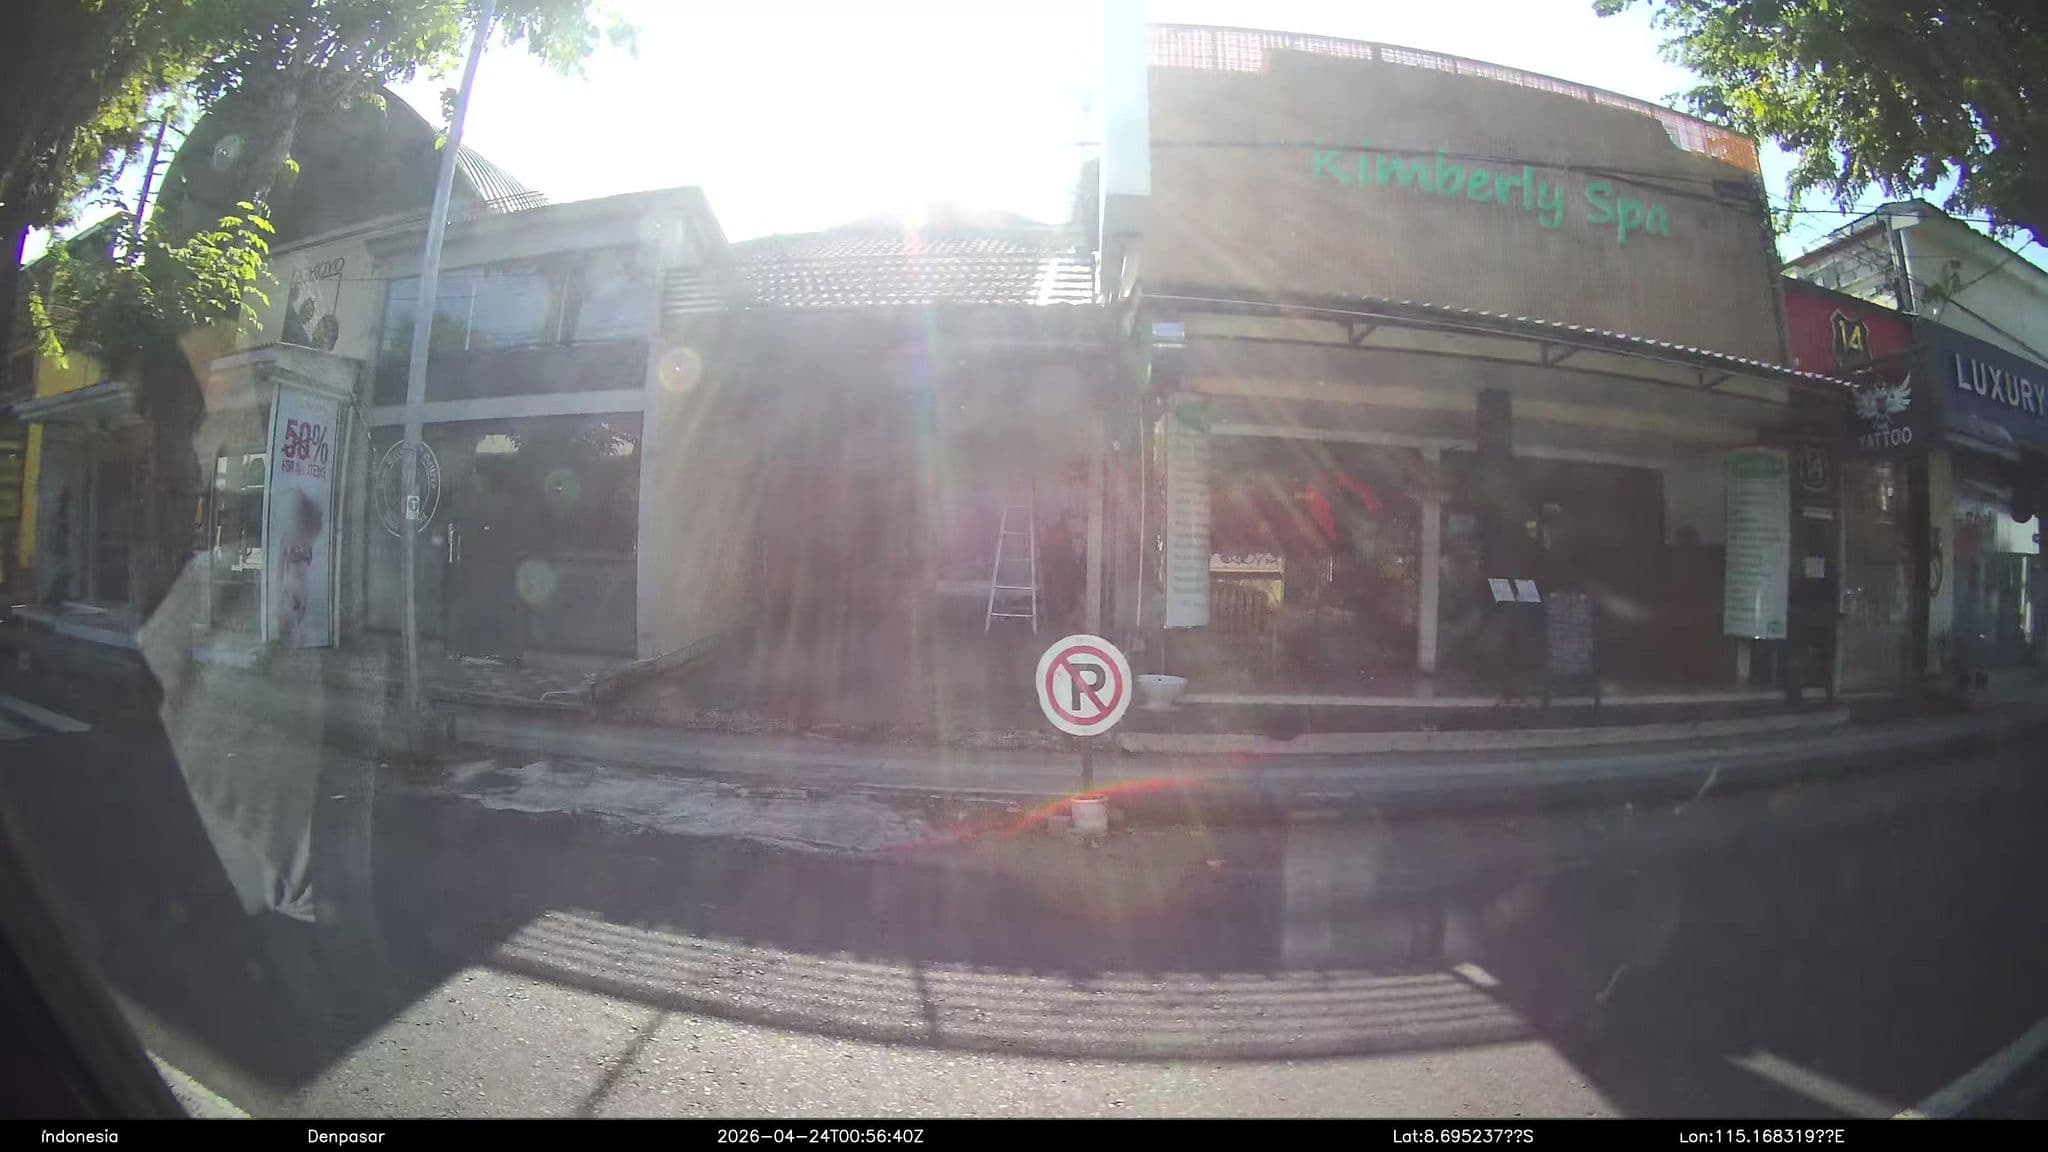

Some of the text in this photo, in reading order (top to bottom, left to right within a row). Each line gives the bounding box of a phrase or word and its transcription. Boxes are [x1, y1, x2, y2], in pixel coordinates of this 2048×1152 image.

[1312, 138, 1672, 245] Kimberly Spa
[1839, 318, 1864, 351] 14
[1955, 352, 2048, 417] LUXURY
[1858, 426, 1913, 449] TATTOO
